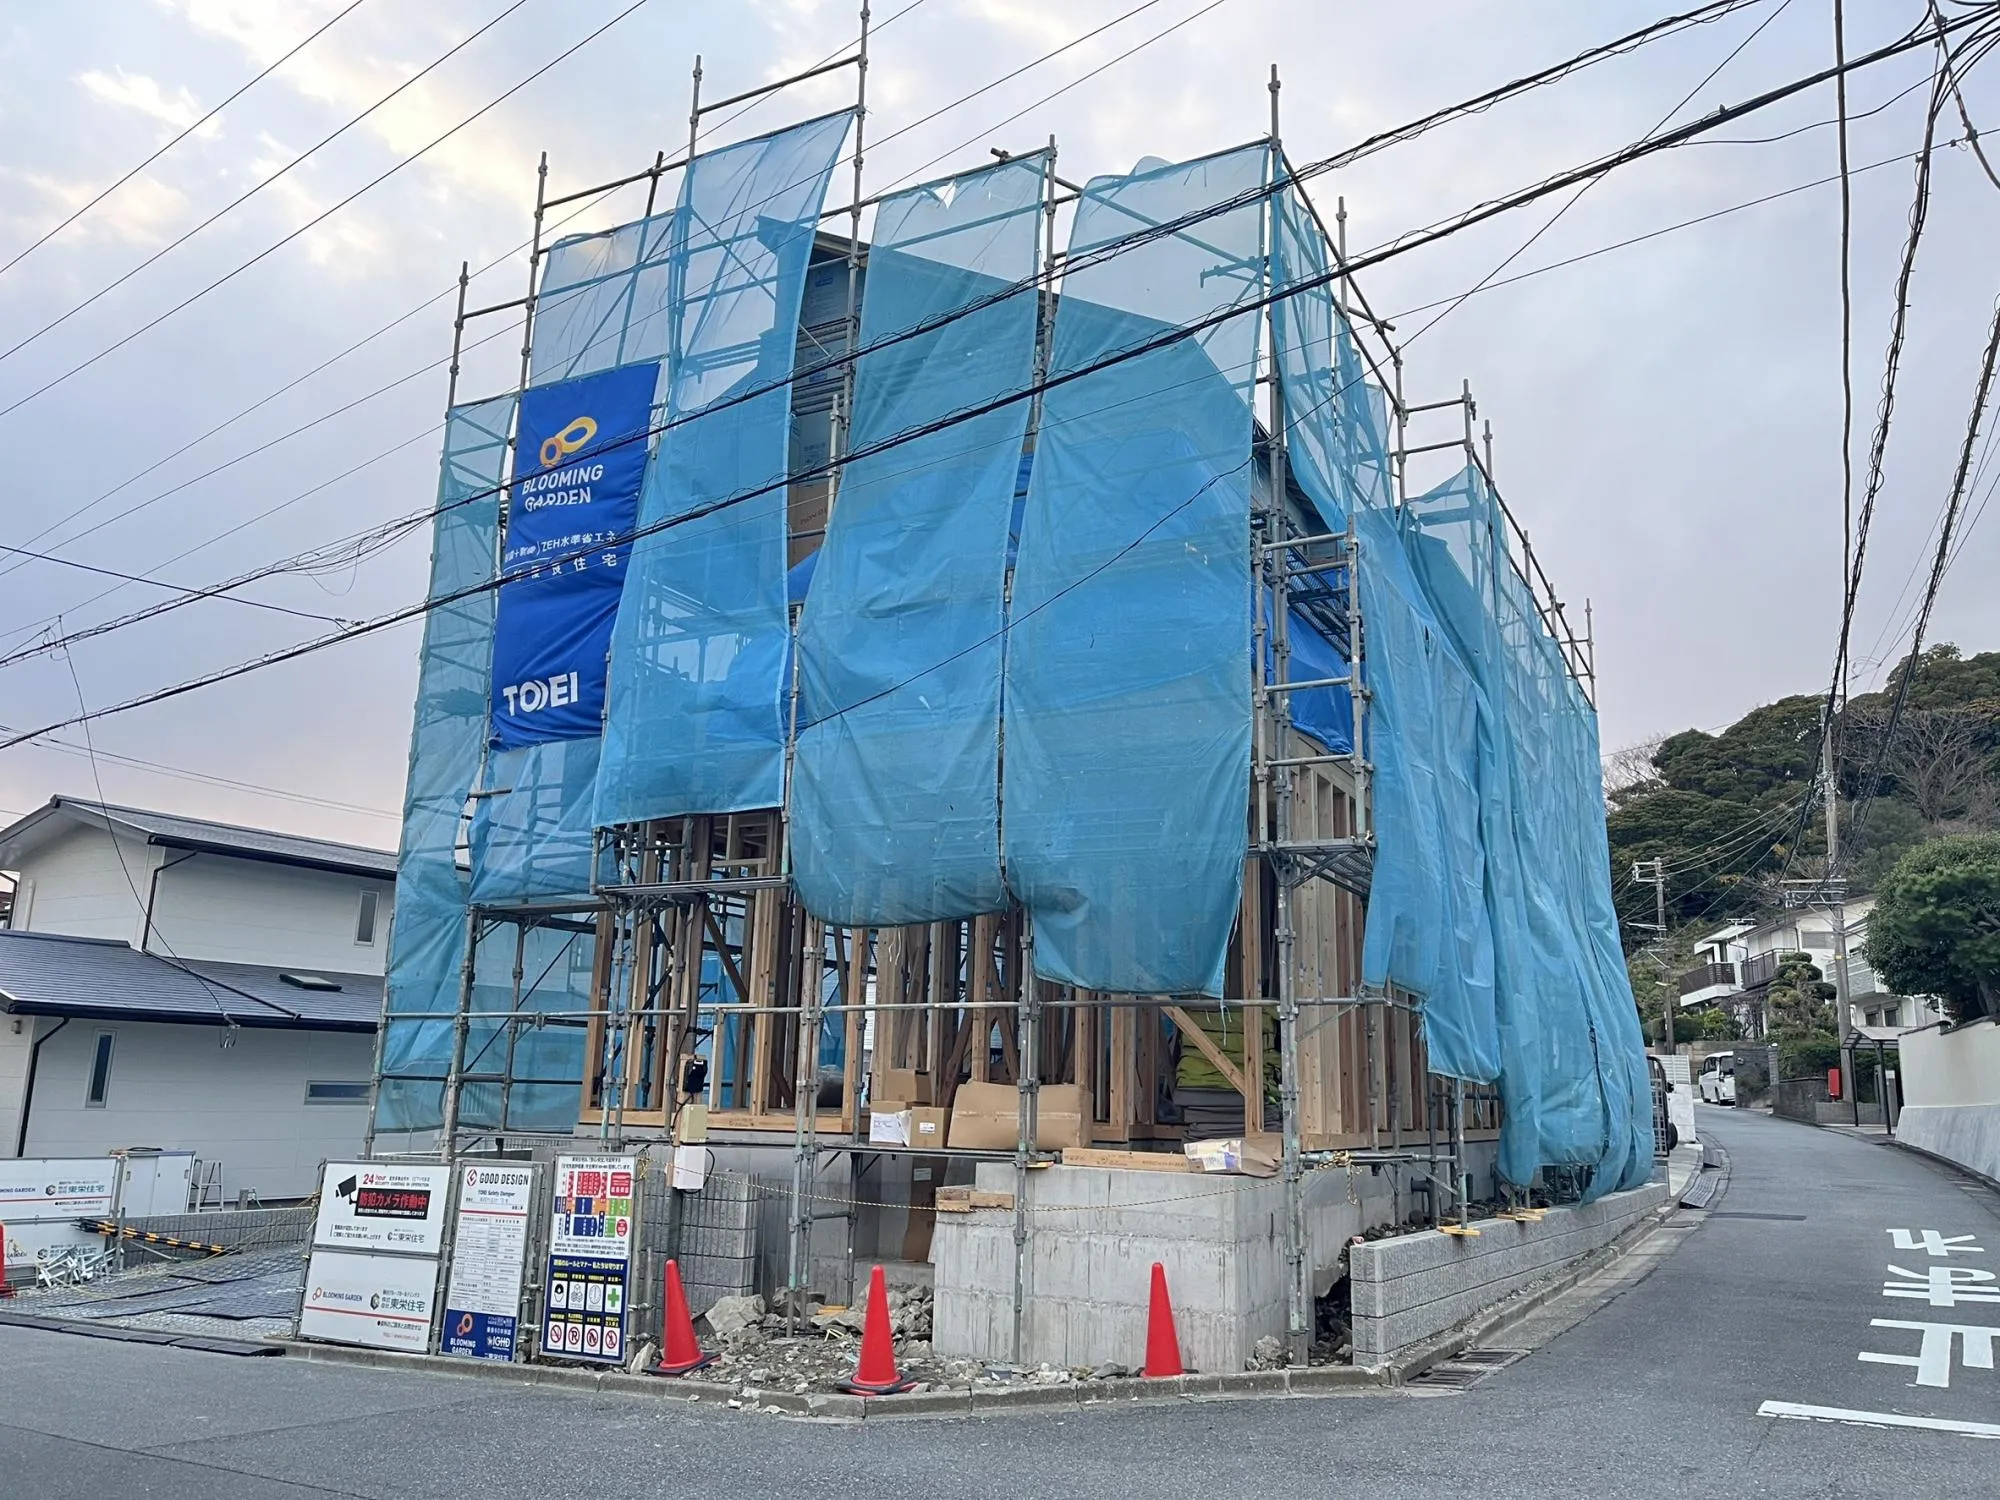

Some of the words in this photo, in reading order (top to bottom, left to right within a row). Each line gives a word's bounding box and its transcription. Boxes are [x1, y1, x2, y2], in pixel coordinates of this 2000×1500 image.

[522, 464, 604, 496] BLOOMING
[525, 487, 592, 513] GARDEN
[503, 671, 579, 717] TOEI
[363, 1173, 374, 1185] 24
[479, 1172, 499, 1185] GOOD
[501, 1174, 529, 1186] DESIGN
[358, 1191, 428, 1209] 防犯カメラ作動中
[322, 1291, 344, 1301] BLOOMING
[345, 1294, 363, 1302] GARDEN
[390, 1299, 426, 1313] 東栄住宅
[449, 1337, 476, 1348] BLOOMING
[451, 1346, 473, 1356] GARDEN
